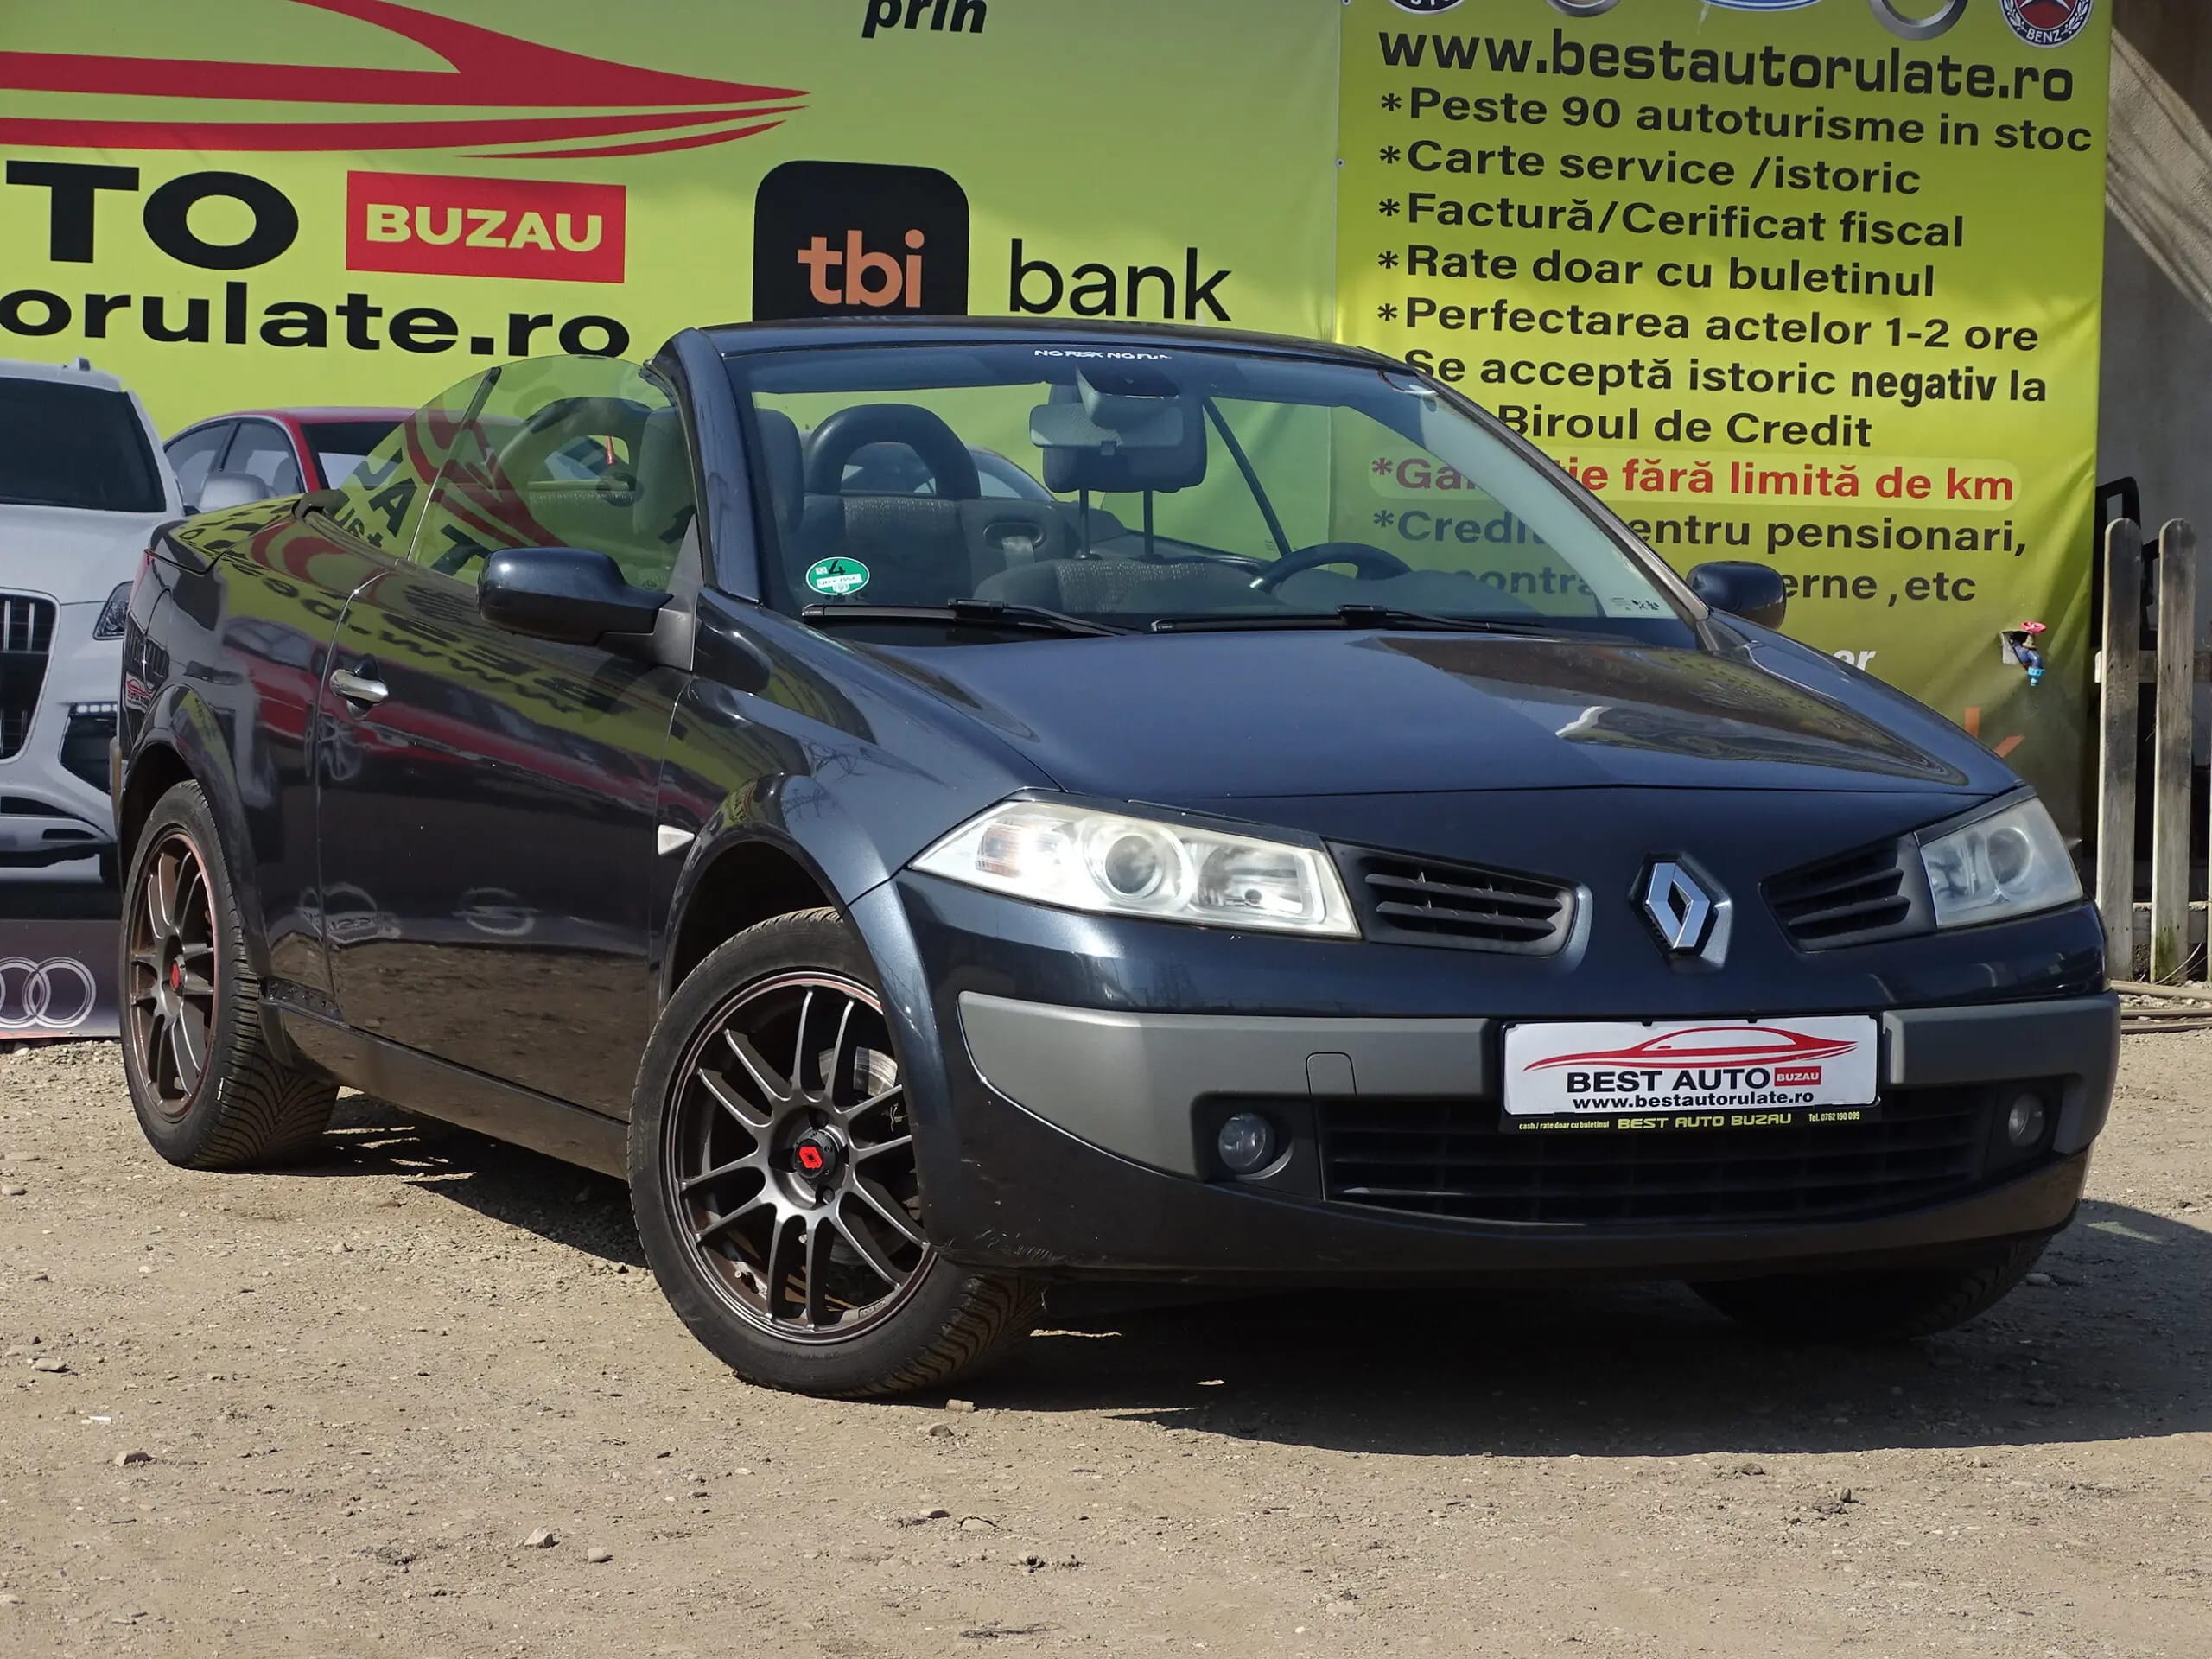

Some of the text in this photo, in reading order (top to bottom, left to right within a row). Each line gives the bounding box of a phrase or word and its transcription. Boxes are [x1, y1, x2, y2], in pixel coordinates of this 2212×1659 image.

[861, 0, 987, 38] prin
[2026, 28, 2062, 43] BENZ
[1379, 28, 2073, 101] www.bestautorulate.ro
[1562, 96, 1620, 128] 90
[1637, 104, 1924, 143] autoturisme
[1940, 113, 1979, 146] in
[1994, 120, 2092, 151] stoc
[1560, 150, 1735, 186] service
[1750, 156, 1921, 194] /istoric
[365, 202, 603, 252] BUZAU
[1840, 210, 1963, 247] fiscal
[797, 229, 1232, 322] tbi bank
[1532, 249, 1643, 285] doar
[1657, 263, 1712, 289] cu
[1729, 257, 1934, 296] buletinul
[1706, 311, 1872, 346] actelor
[1885, 317, 1949, 348] 1-2
[1965, 325, 2038, 351] ore
[1404, 349, 2046, 408] Se acceptă istoric negativ la
[1497, 404, 1872, 447] Biroul de Credit
[1622, 458, 1713, 493] fără
[1731, 461, 1859, 497] limită
[1875, 467, 1931, 499] de
[1947, 467, 2013, 501] km
[1629, 515, 1750, 546] entru
[1767, 517, 2026, 556] pensionari,
[828, 560, 845, 575] 4
[1567, 1068, 1820, 1093] BEST AUTO BUZAU
[1573, 1091, 1814, 1109] www.bestautorulate.ro
[1519, 1122, 1535, 1130] cash
[1554, 1121, 1570, 1129] doar
[1580, 1120, 1610, 1129] buletinul
[1618, 1113, 1791, 1129] BEST AUTO BUZAU
